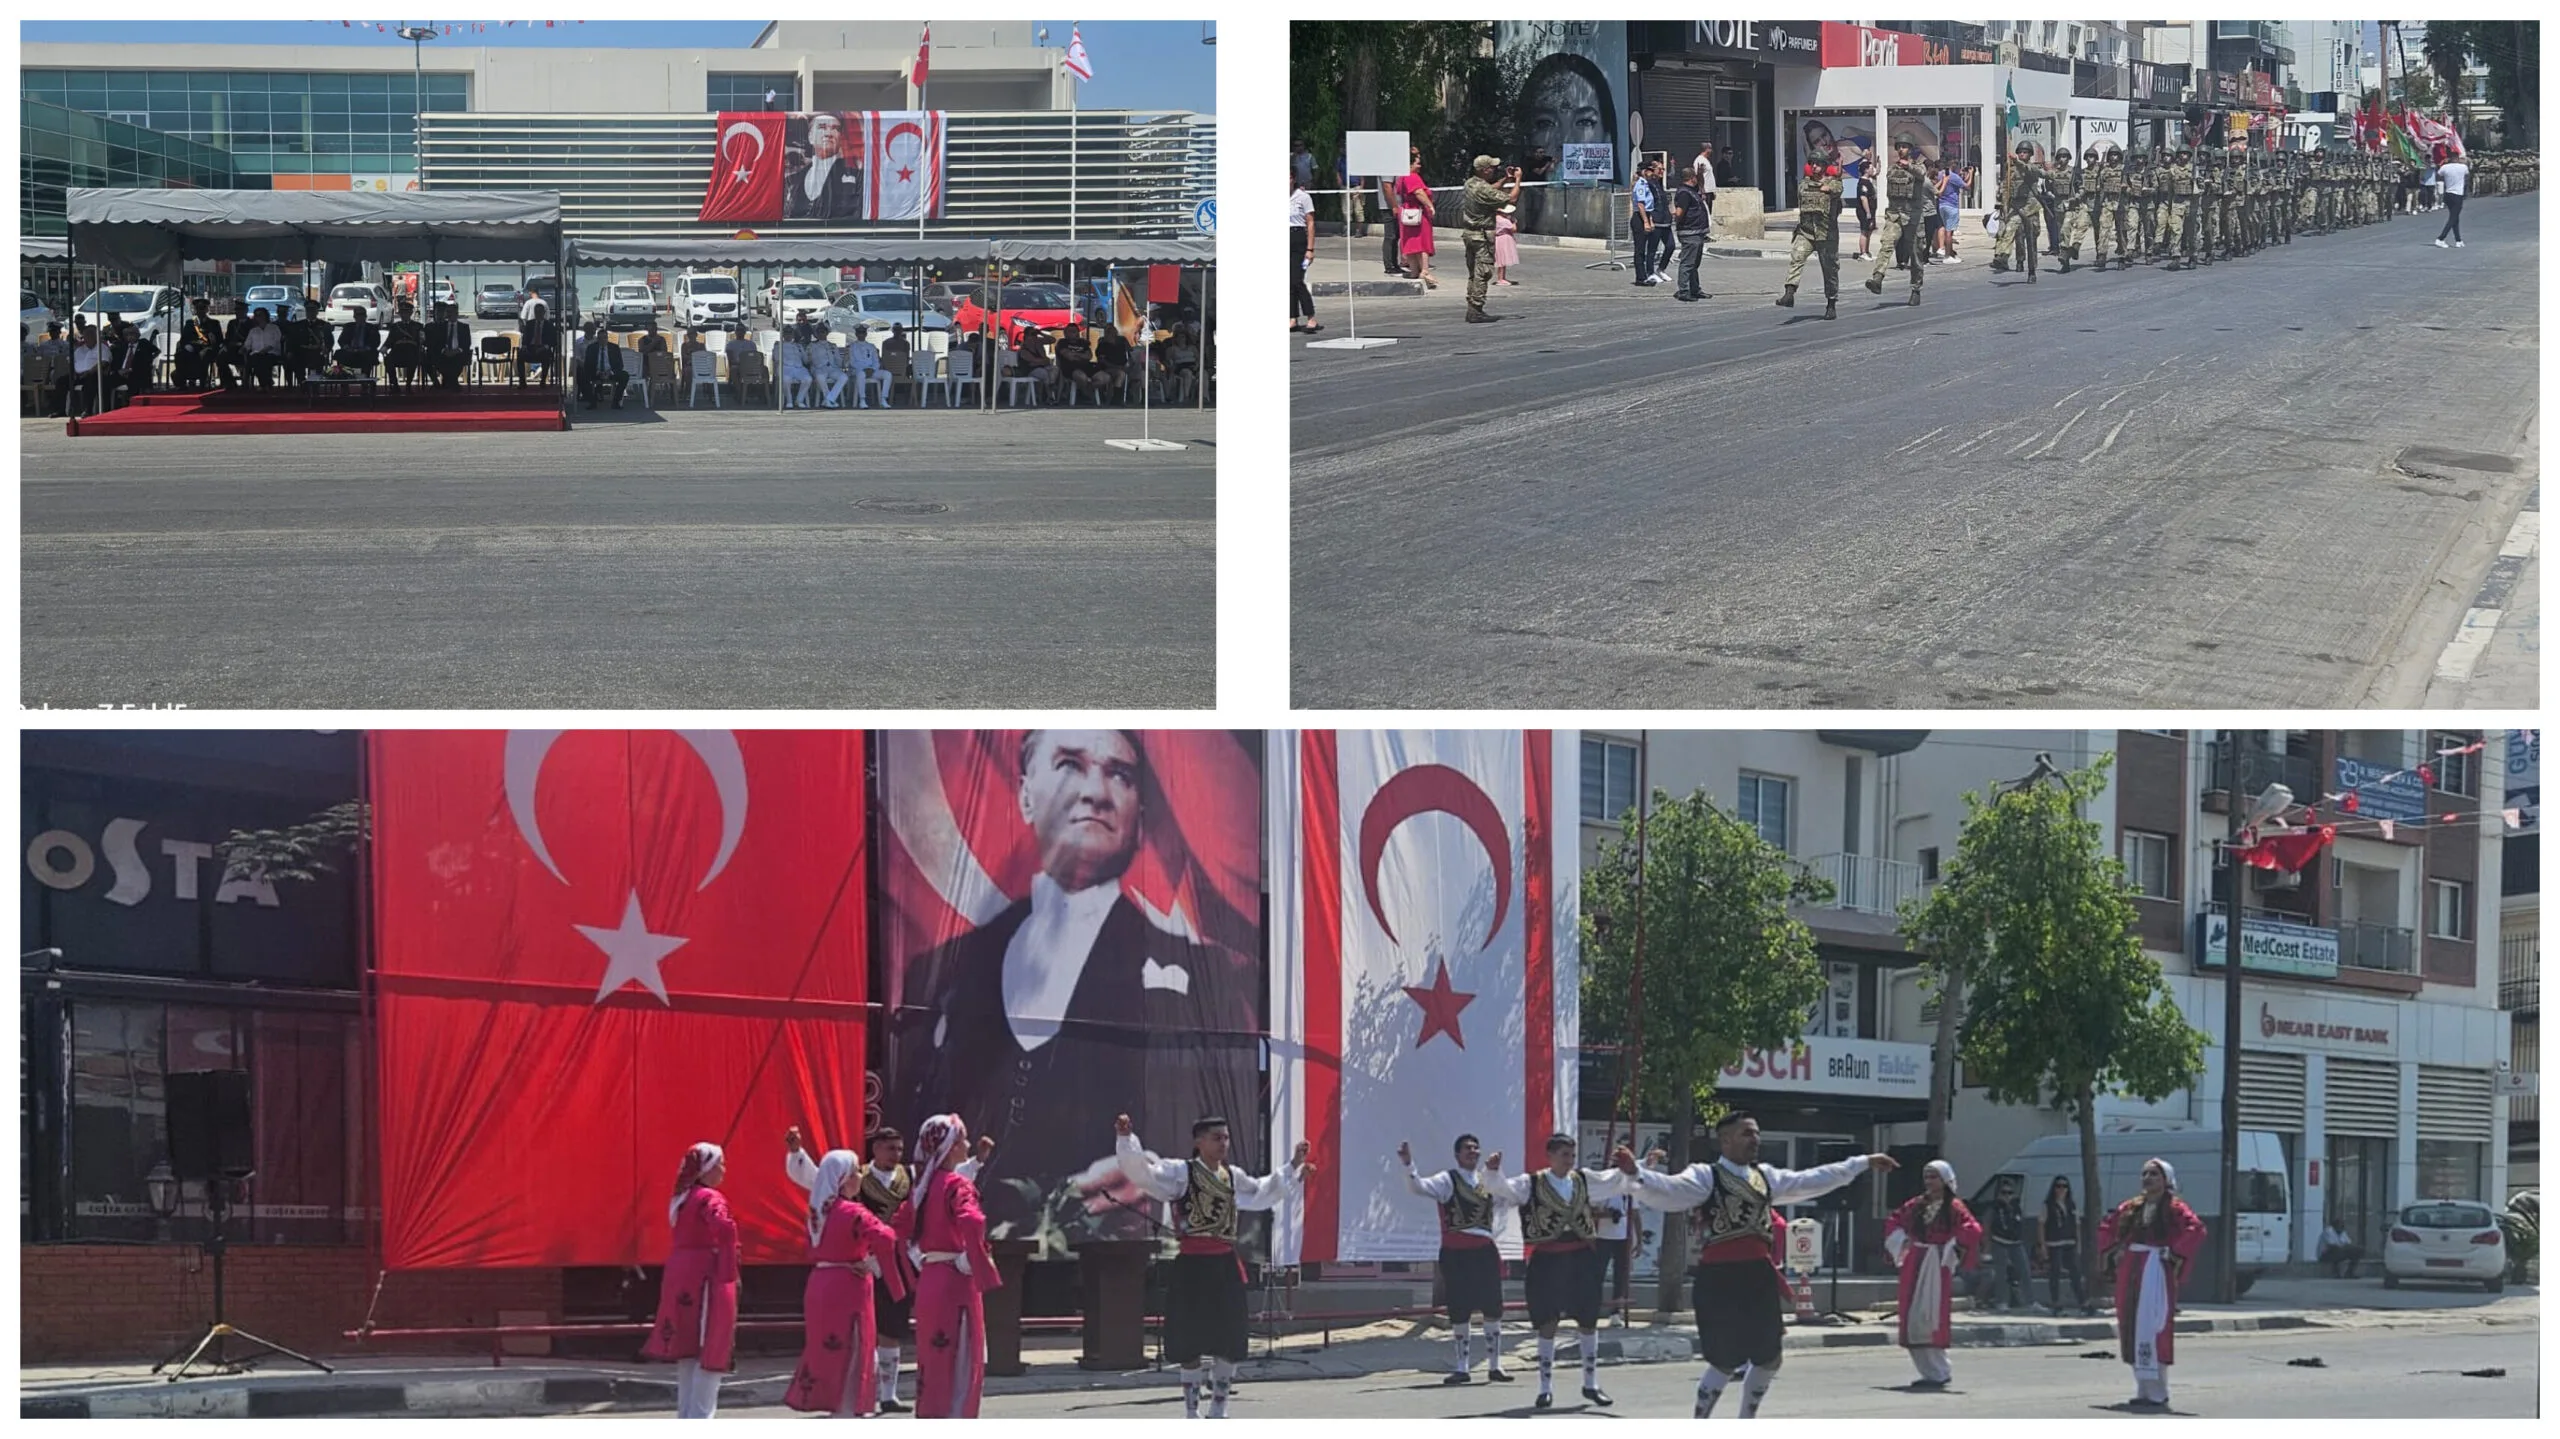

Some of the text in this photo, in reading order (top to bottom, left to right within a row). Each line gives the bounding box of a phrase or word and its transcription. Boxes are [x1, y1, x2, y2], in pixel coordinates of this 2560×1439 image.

[1533, 22, 1591, 37] NOTE
[1788, 36, 1818, 52] PARFUMEUR
[2154, 75, 2183, 94] URBANITY
[2090, 121, 2117, 134] SAW
[1566, 160, 1581, 170] OTO
[2243, 934, 2336, 962] MedCoast Estate
[2277, 1019, 2389, 1044] NEAR EAST BANK
[1828, 1053, 1870, 1080] BRAUN
